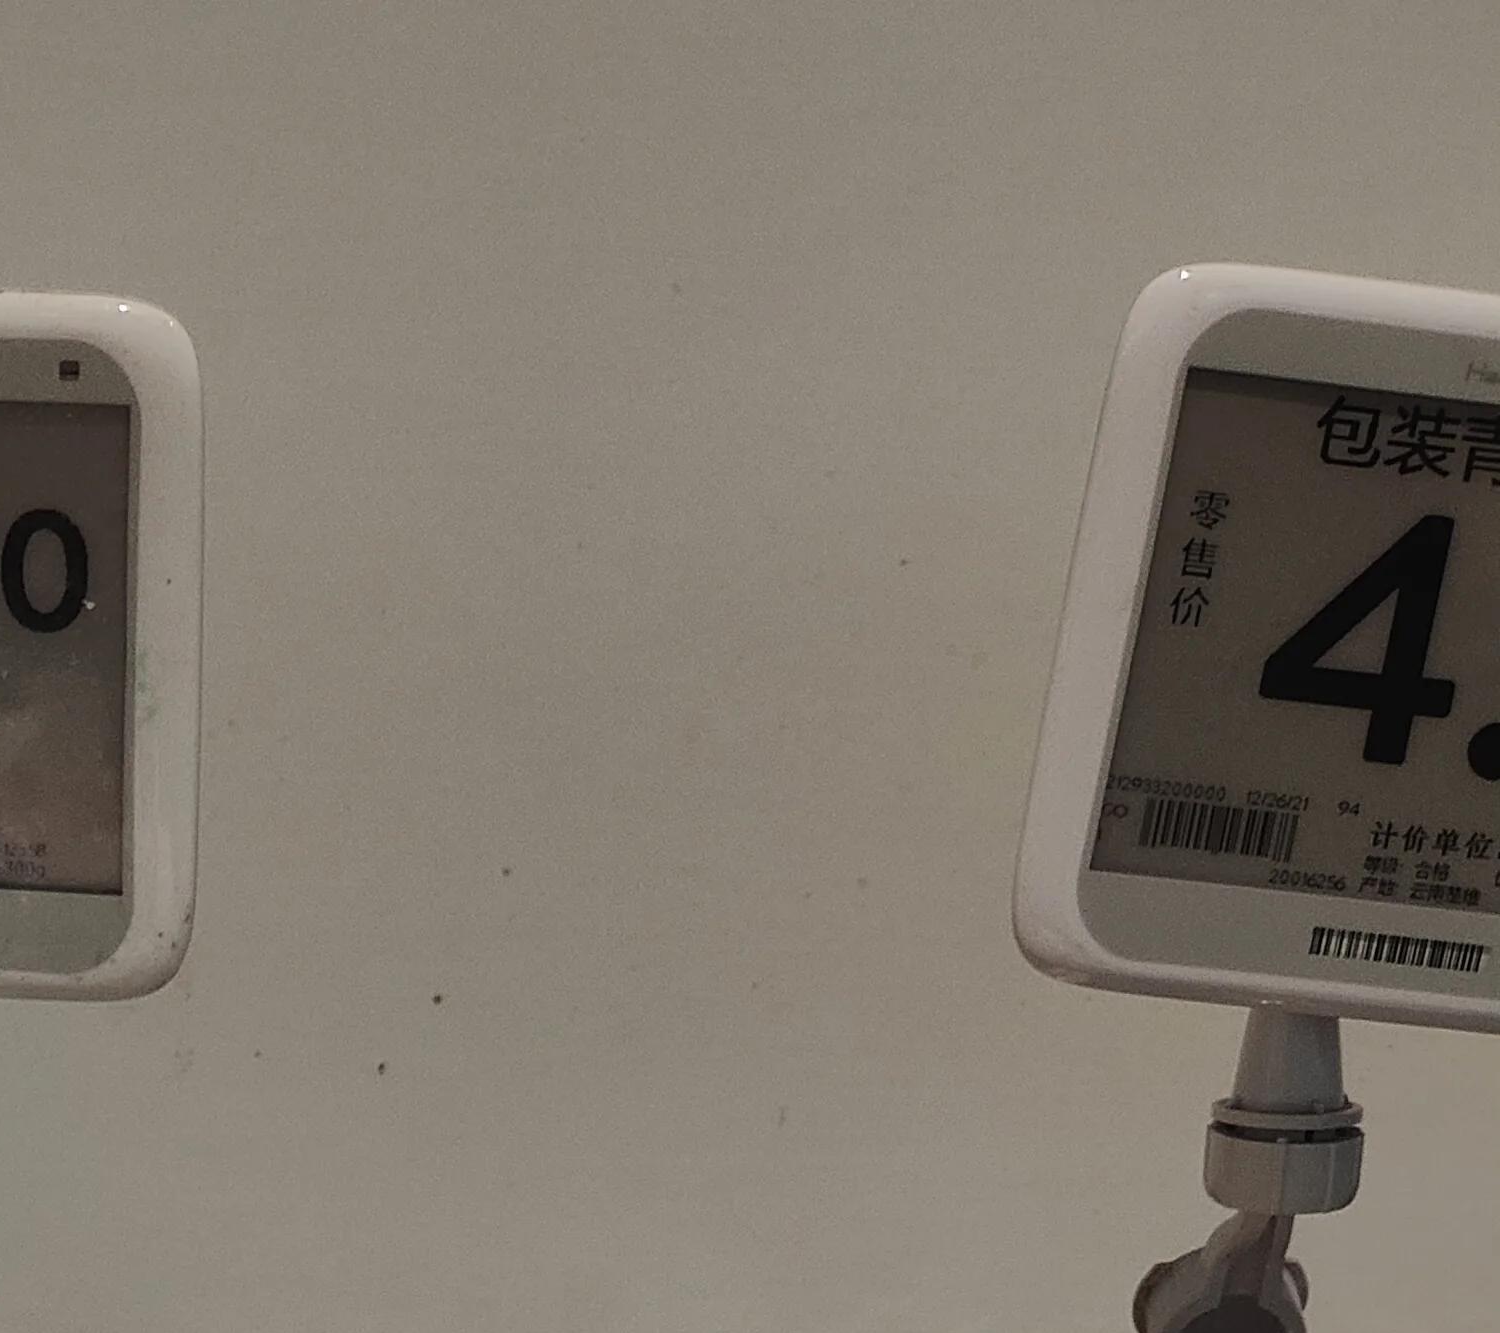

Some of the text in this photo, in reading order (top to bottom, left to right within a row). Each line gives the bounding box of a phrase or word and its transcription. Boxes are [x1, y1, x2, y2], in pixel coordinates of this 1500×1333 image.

[1169, 489, 1230, 628] 零售价
[1337, 799, 1361, 818] 94
